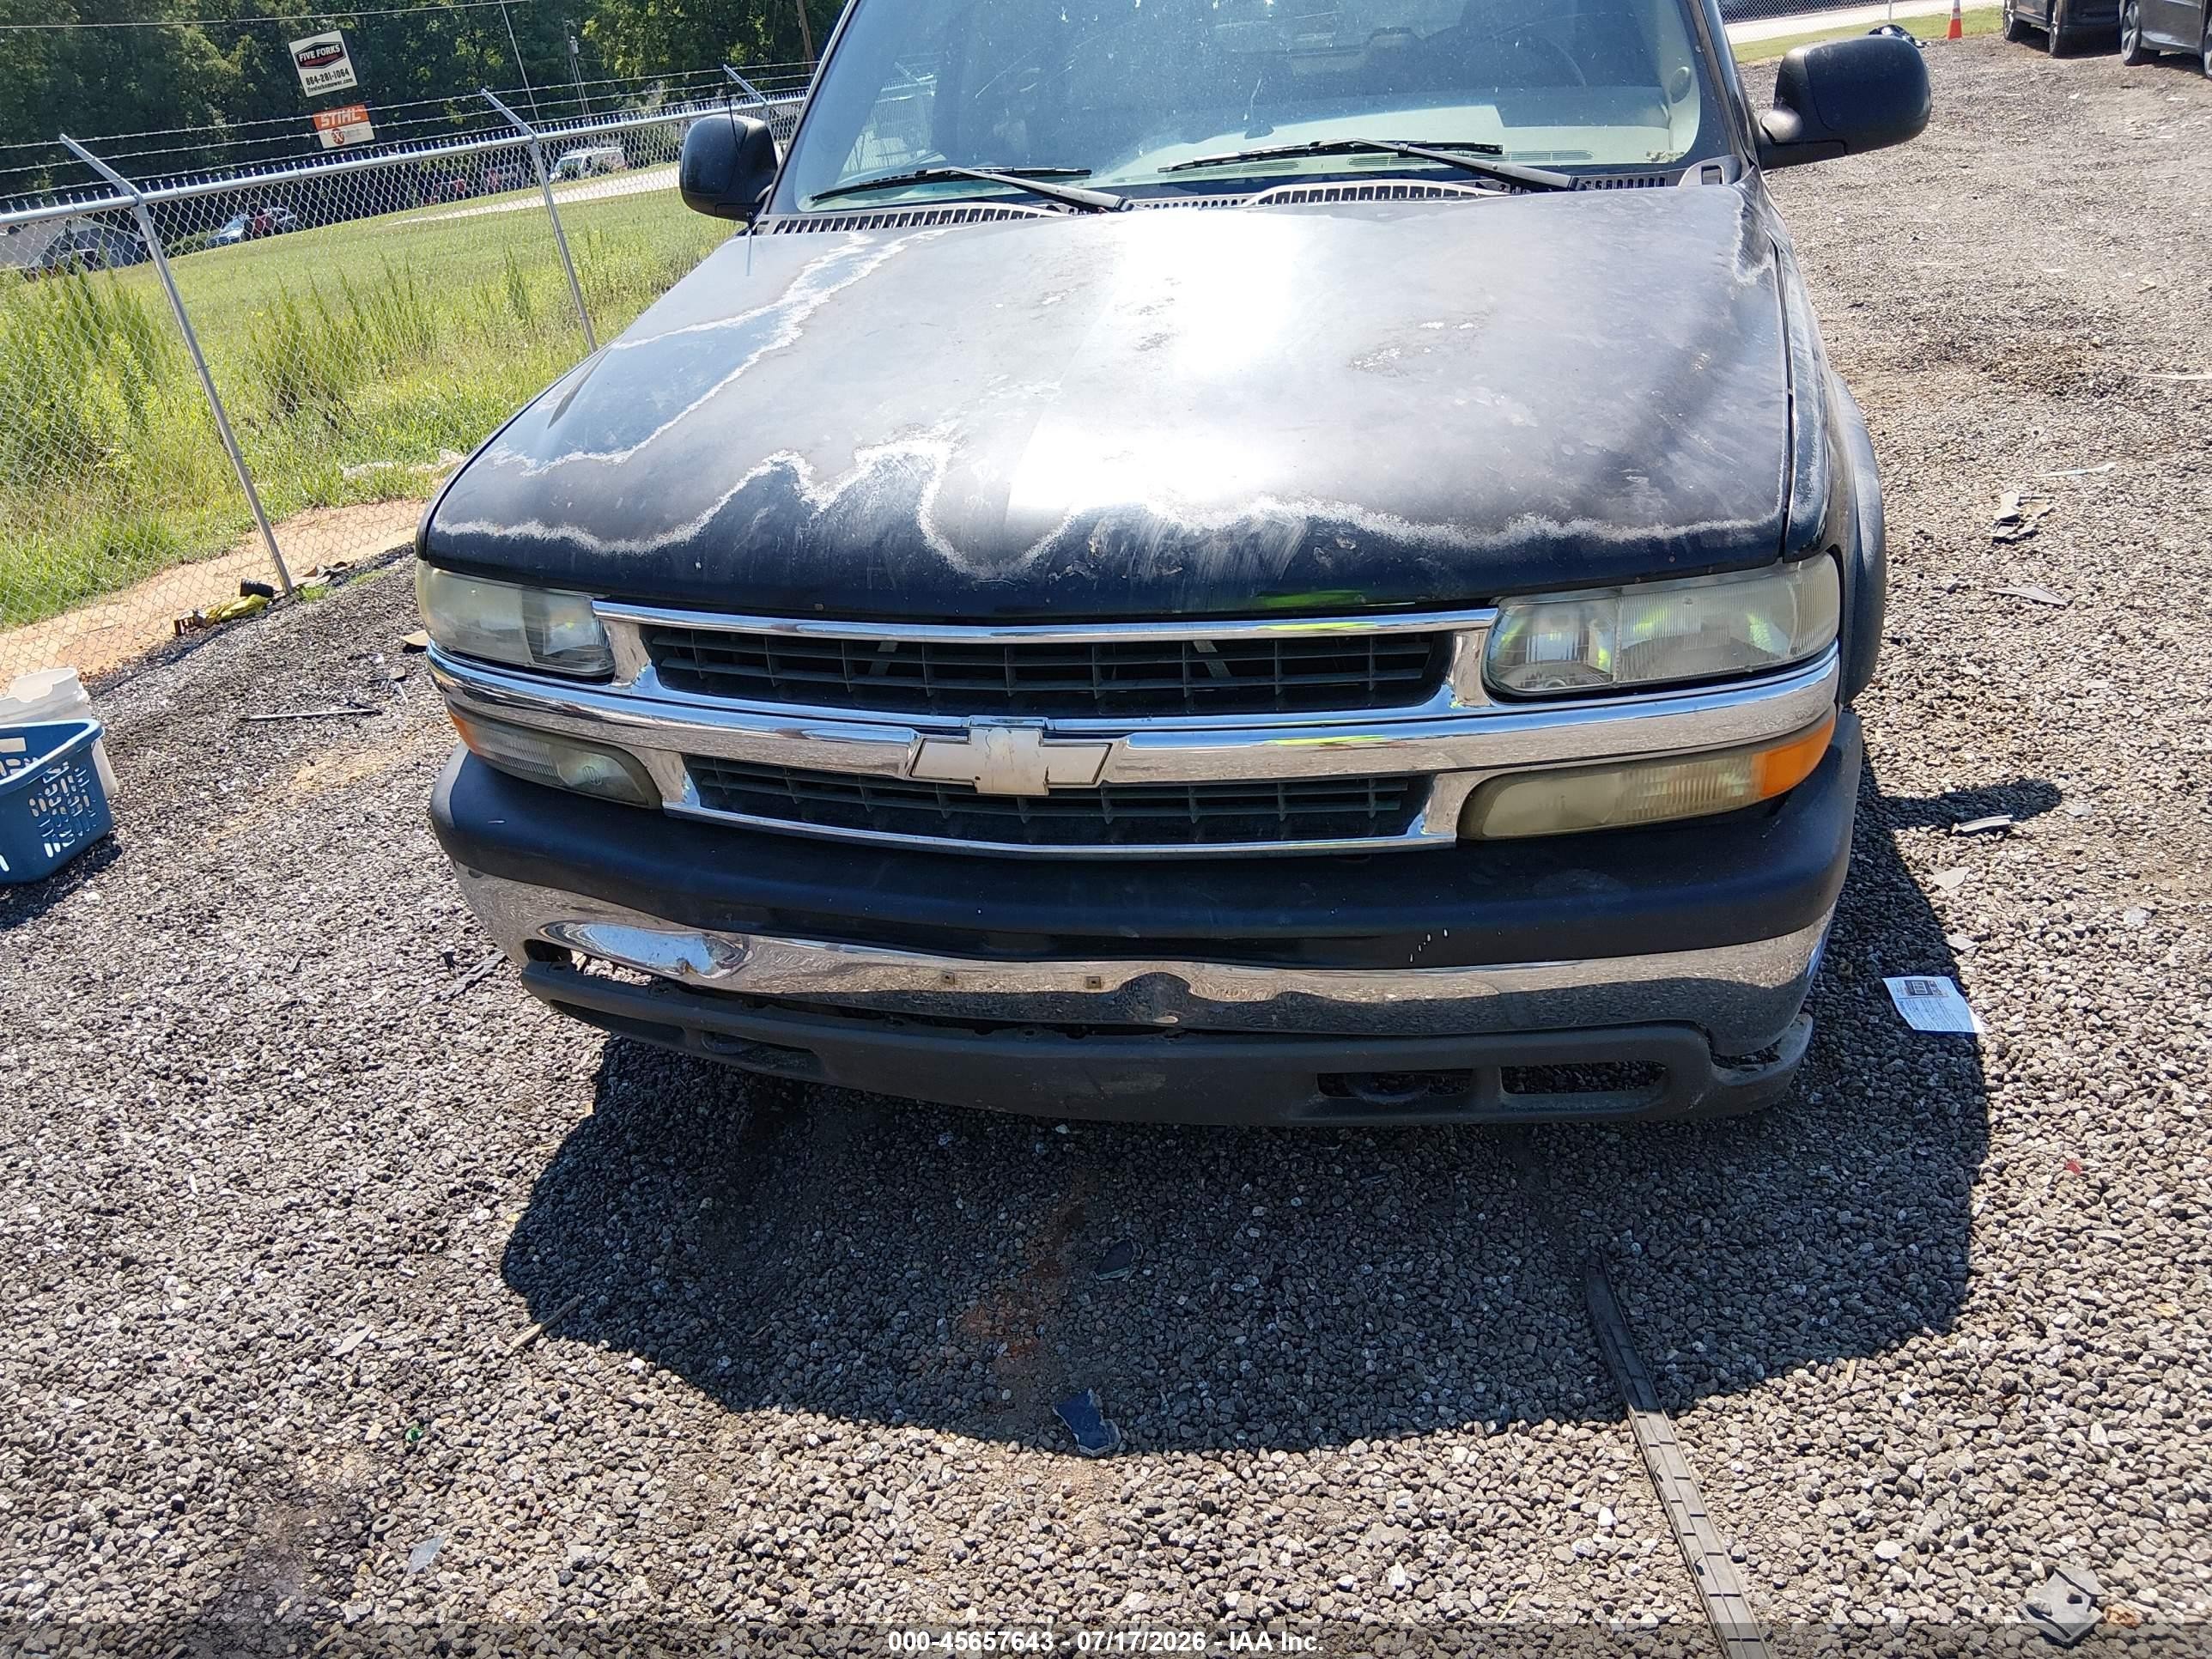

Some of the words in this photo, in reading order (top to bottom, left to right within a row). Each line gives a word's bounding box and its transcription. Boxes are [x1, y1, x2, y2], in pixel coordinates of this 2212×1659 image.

[299, 49, 316, 63] FIVE
[316, 44, 341, 57] FORKS
[320, 107, 362, 127] STIHL
